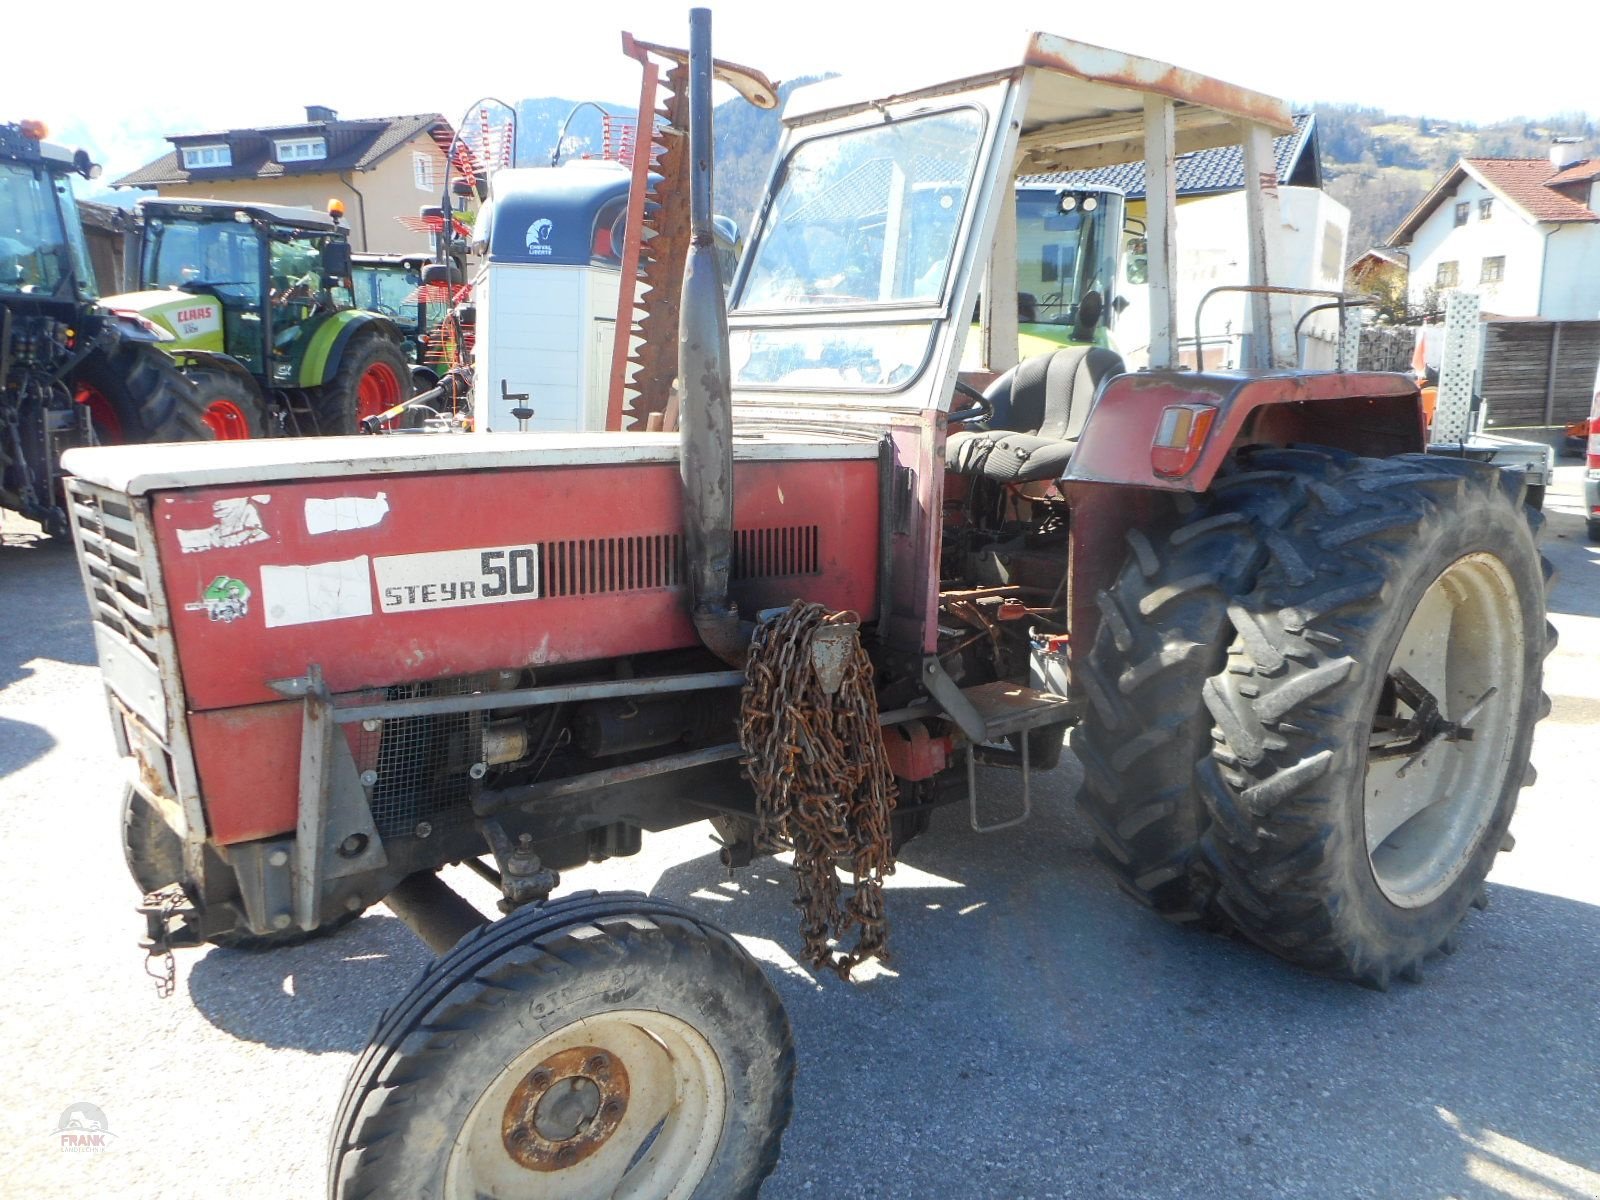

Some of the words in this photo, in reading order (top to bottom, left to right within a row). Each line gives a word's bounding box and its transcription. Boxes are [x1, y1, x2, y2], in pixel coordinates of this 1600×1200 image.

[177, 307, 212, 322] CLAAS
[385, 581, 476, 606] STEYR
[481, 549, 535, 598] 50
